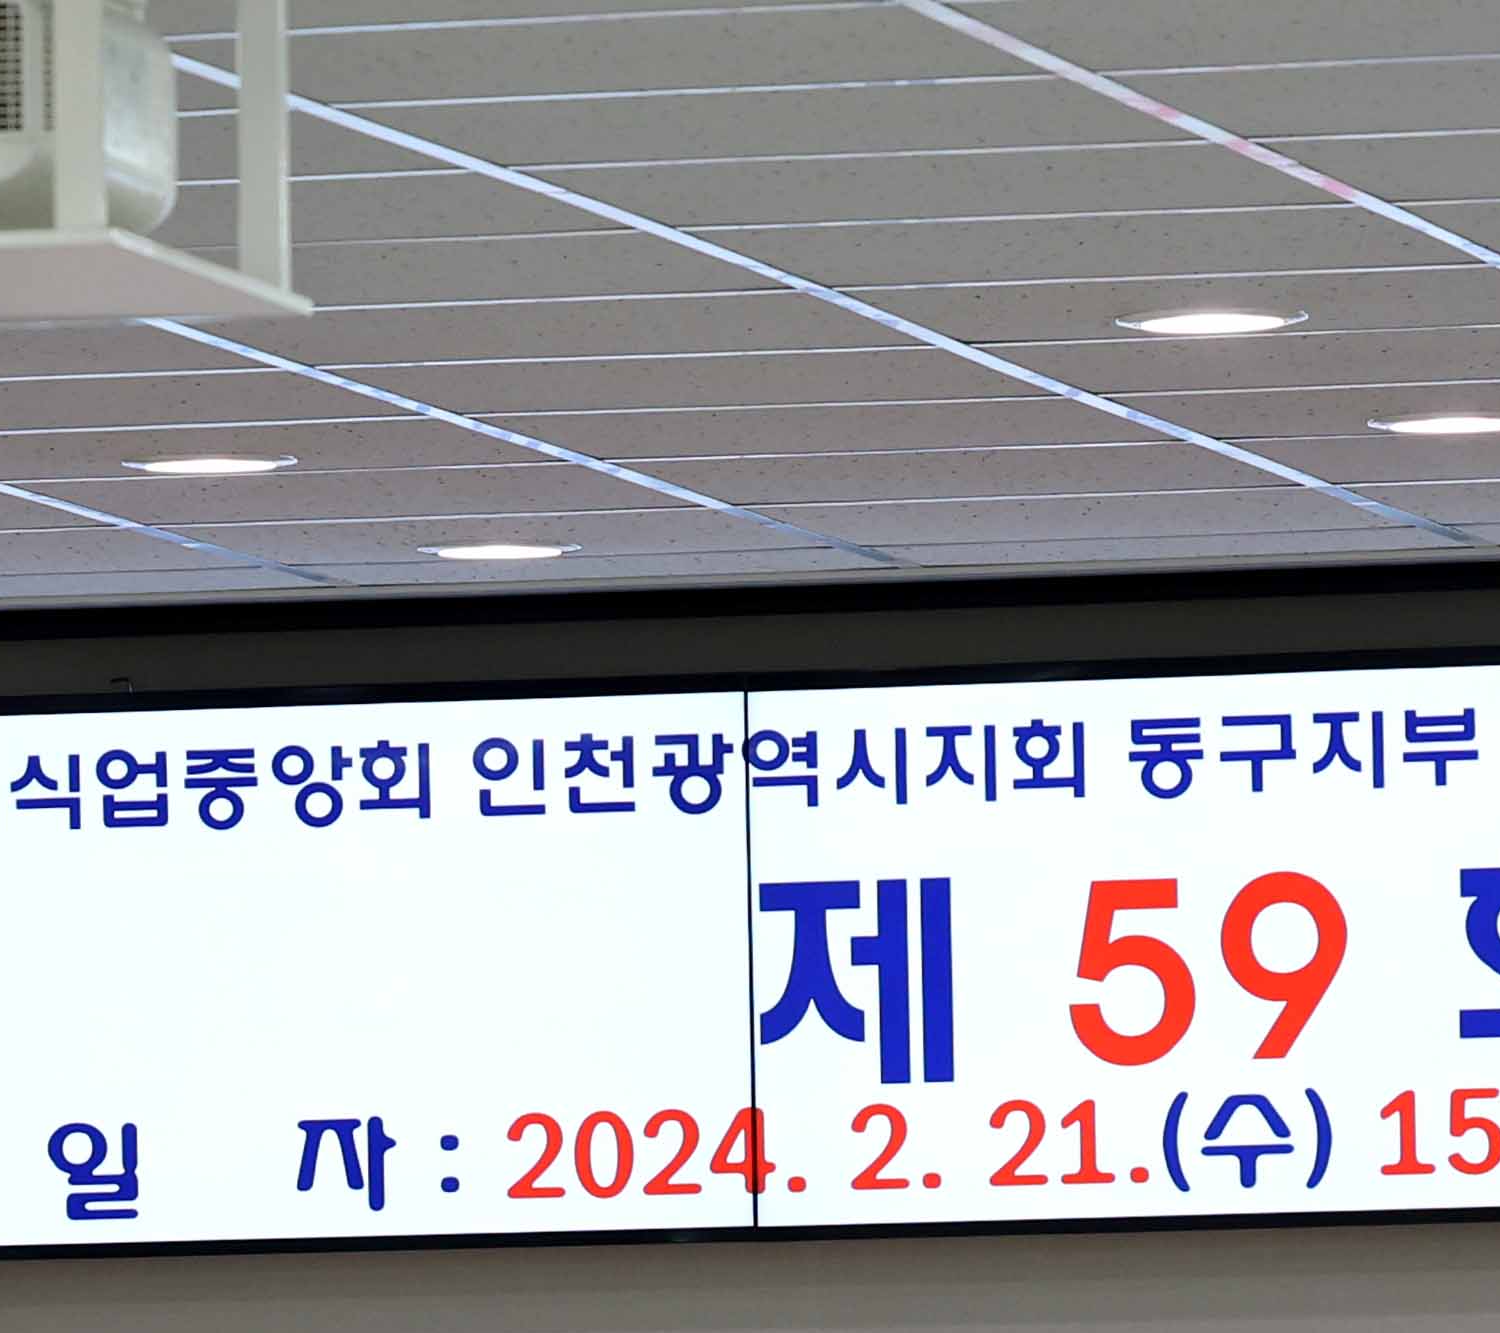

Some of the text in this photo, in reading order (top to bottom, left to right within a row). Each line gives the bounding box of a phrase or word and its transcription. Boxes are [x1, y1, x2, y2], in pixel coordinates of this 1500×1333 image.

[474, 719, 1085, 817] 인천광역시지회
[1129, 708, 1479, 799] 동구지부
[758, 877, 954, 1084] 제
[1070, 871, 1347, 1067] 59
